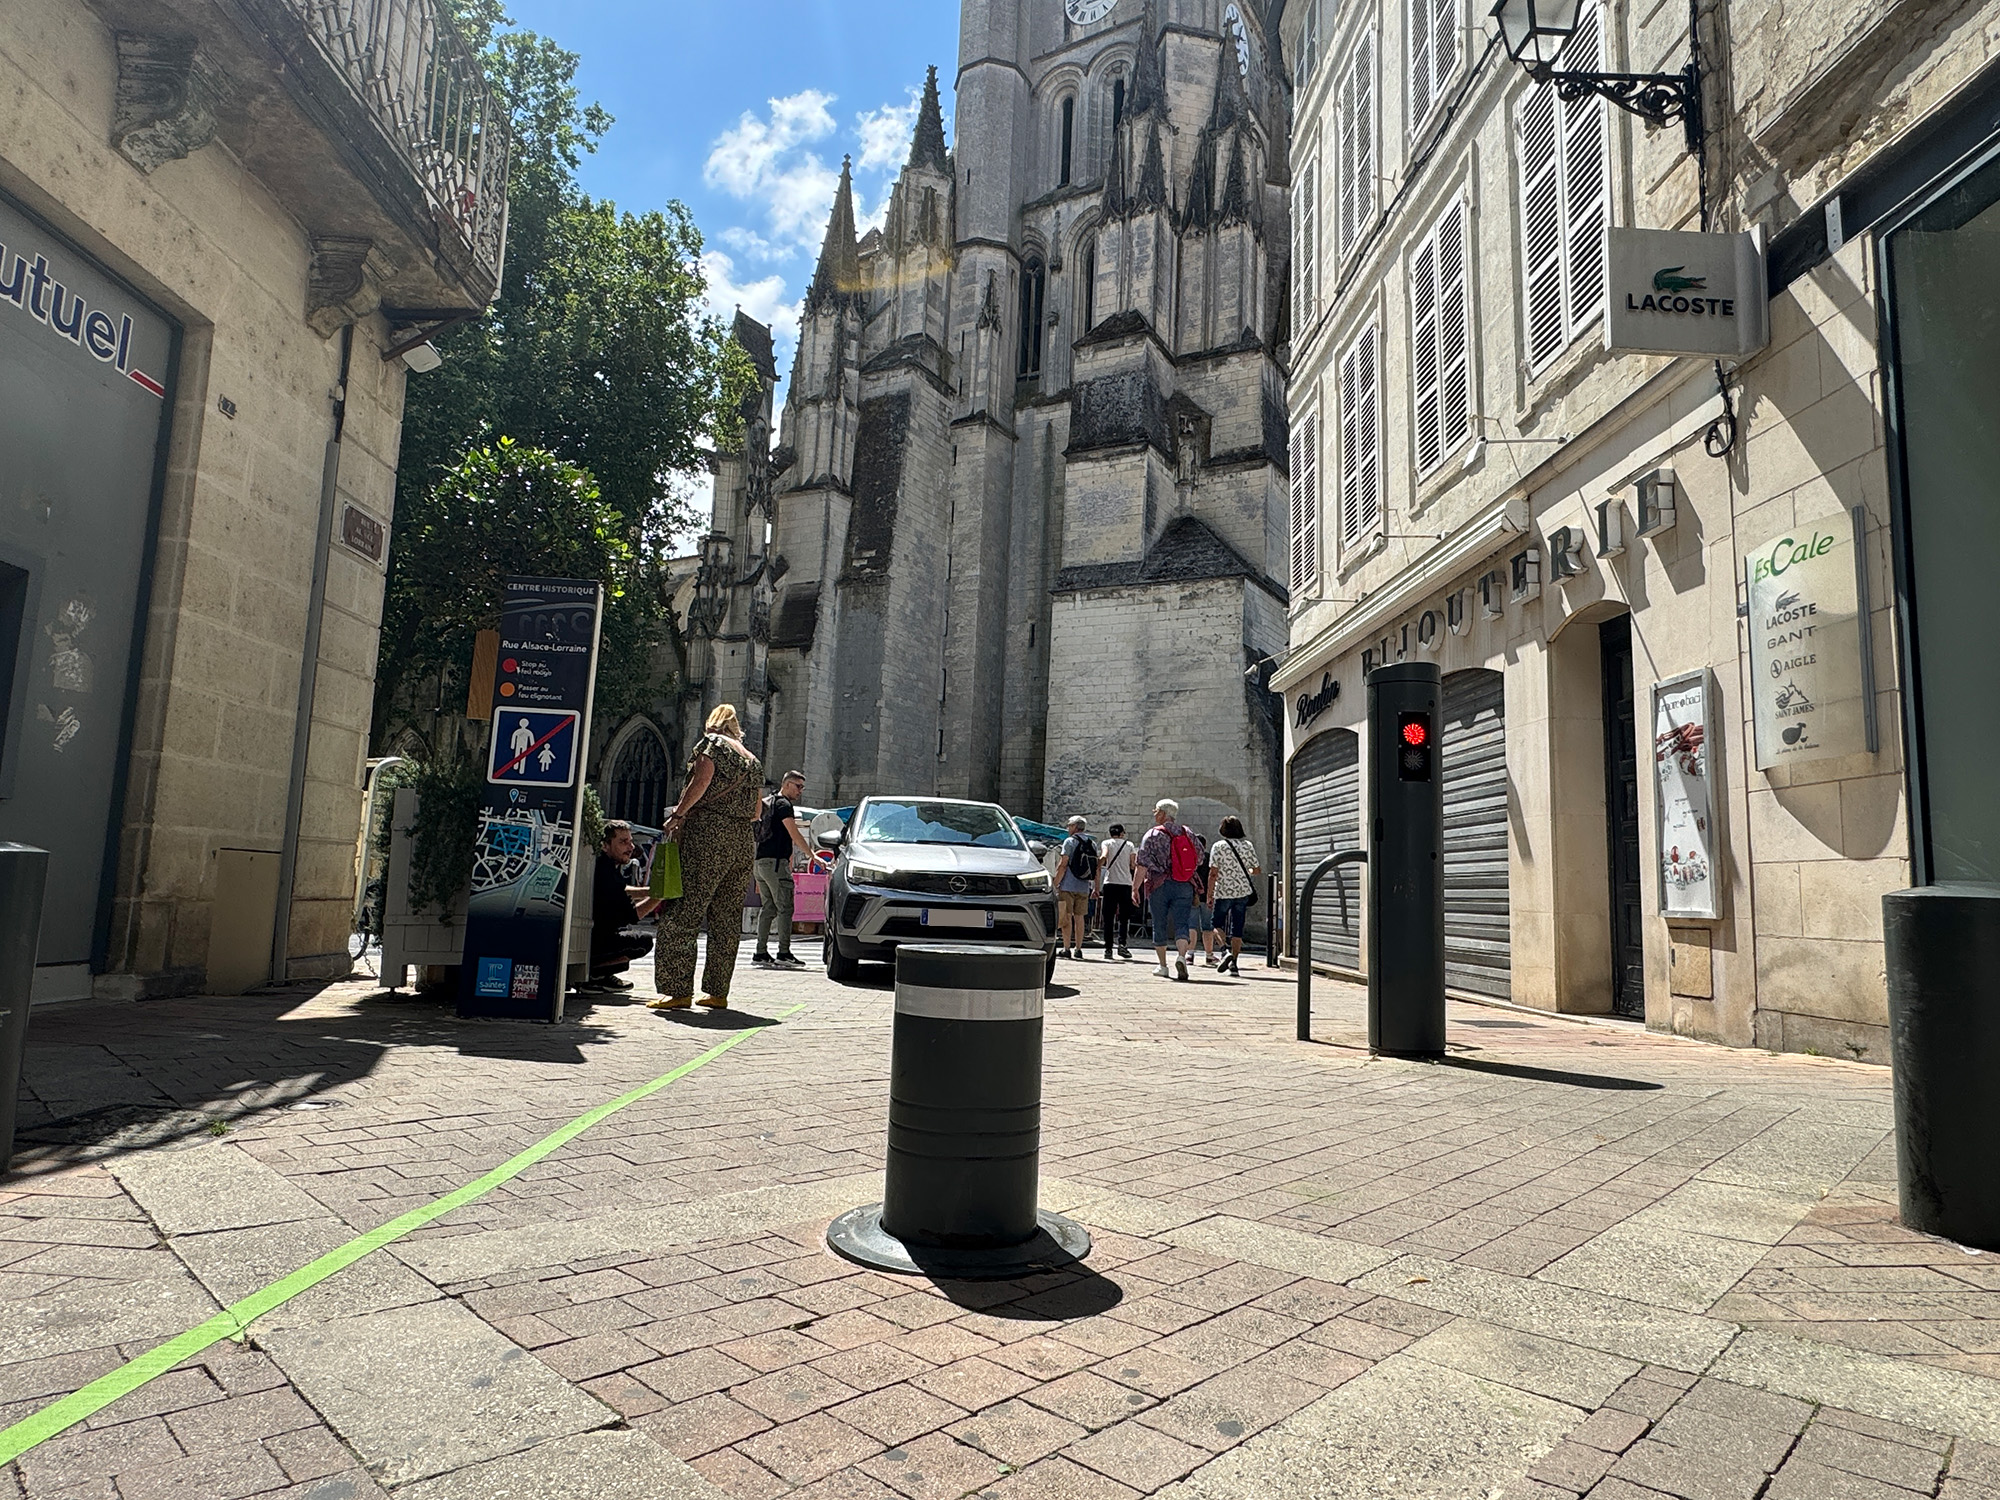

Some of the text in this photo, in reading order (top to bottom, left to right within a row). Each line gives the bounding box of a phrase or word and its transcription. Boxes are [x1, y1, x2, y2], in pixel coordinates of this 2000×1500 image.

[1626, 293, 1735, 317] LACOSTE
[507, 583, 594, 596] CENTRE HISTORIQUE
[1765, 602, 1818, 631] LACOSTE
[1767, 625, 1818, 650] GANT
[502, 640, 587, 653] Rue Alsace-Lorraine
[521, 660, 537, 669] Stop
[1783, 653, 1817, 672] AIGLE
[518, 691, 563, 701] feu clignotant
[1775, 703, 1815, 720] SAINT JAMES
